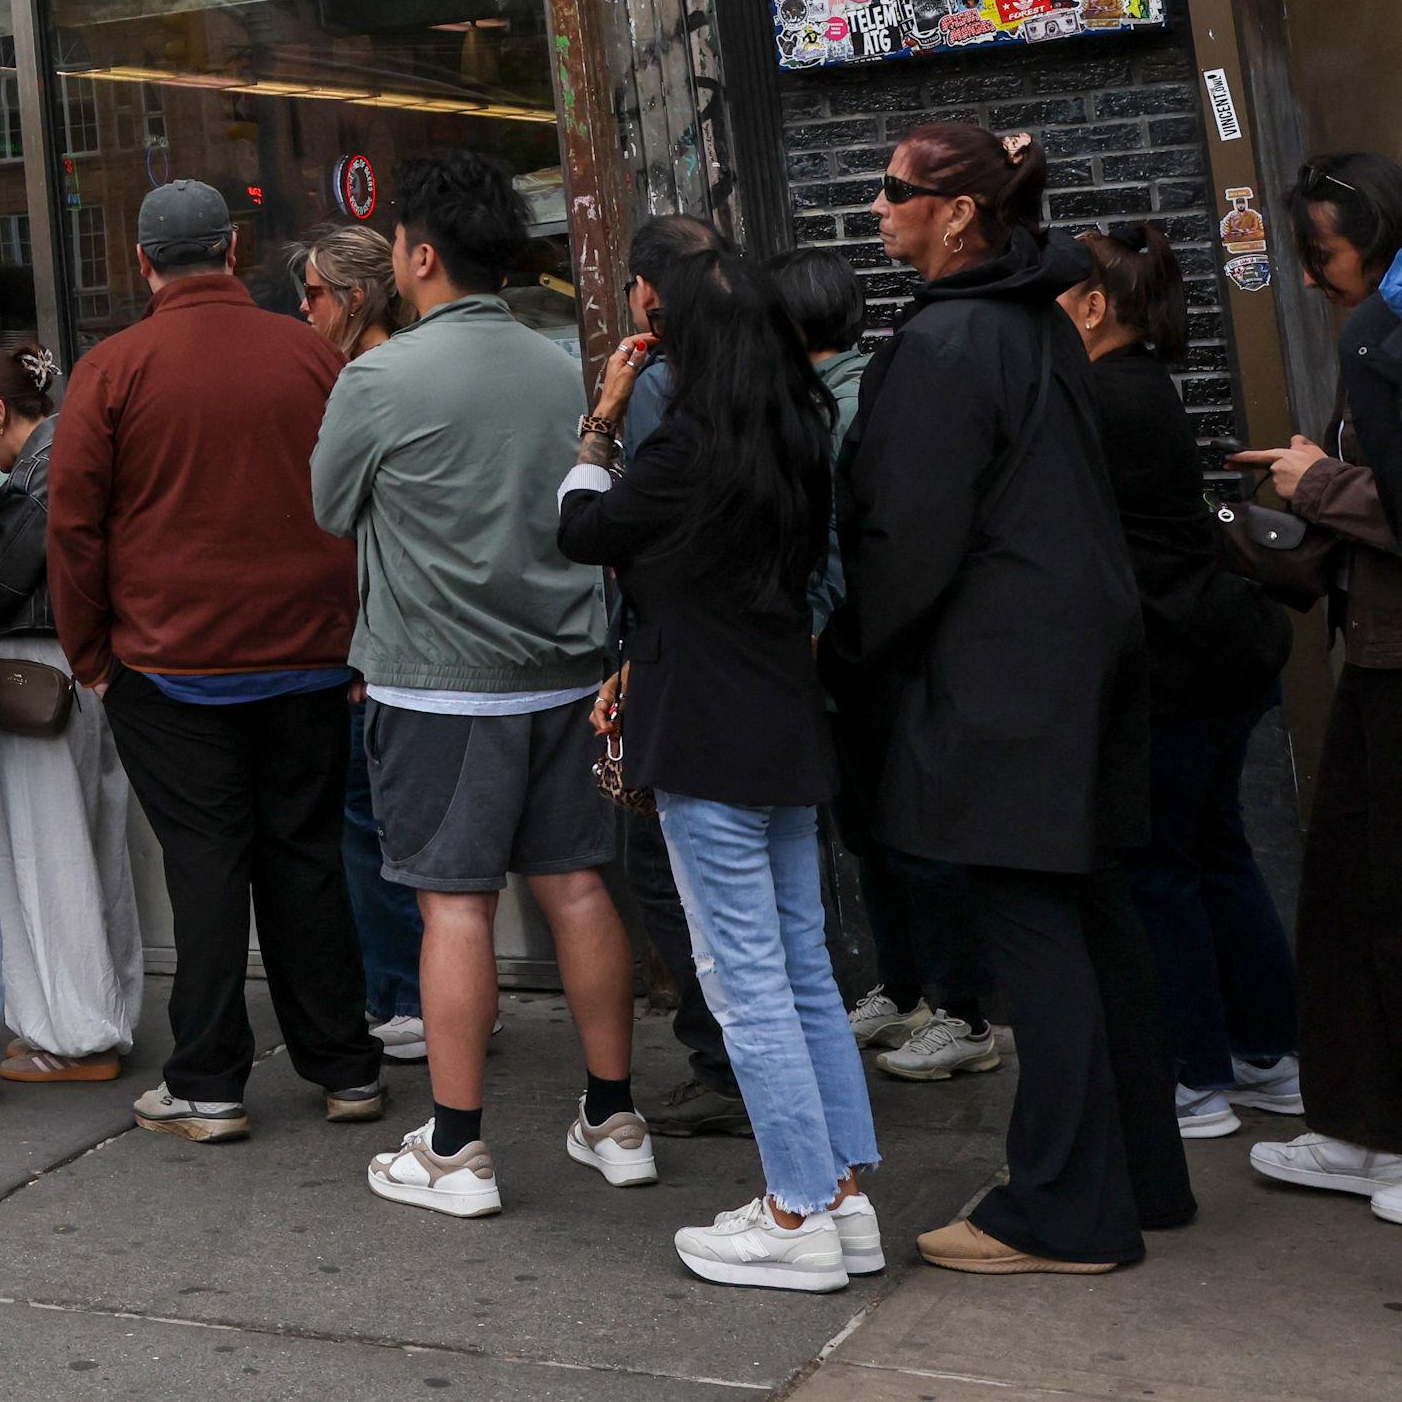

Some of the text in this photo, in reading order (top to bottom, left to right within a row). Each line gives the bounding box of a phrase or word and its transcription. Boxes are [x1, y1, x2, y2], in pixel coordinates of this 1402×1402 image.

[846, 4, 898, 33] TELEM
[1008, 4, 1046, 21] FOREST
[863, 28, 893, 56] ATG
[1212, 96, 1238, 138] VINCENT
